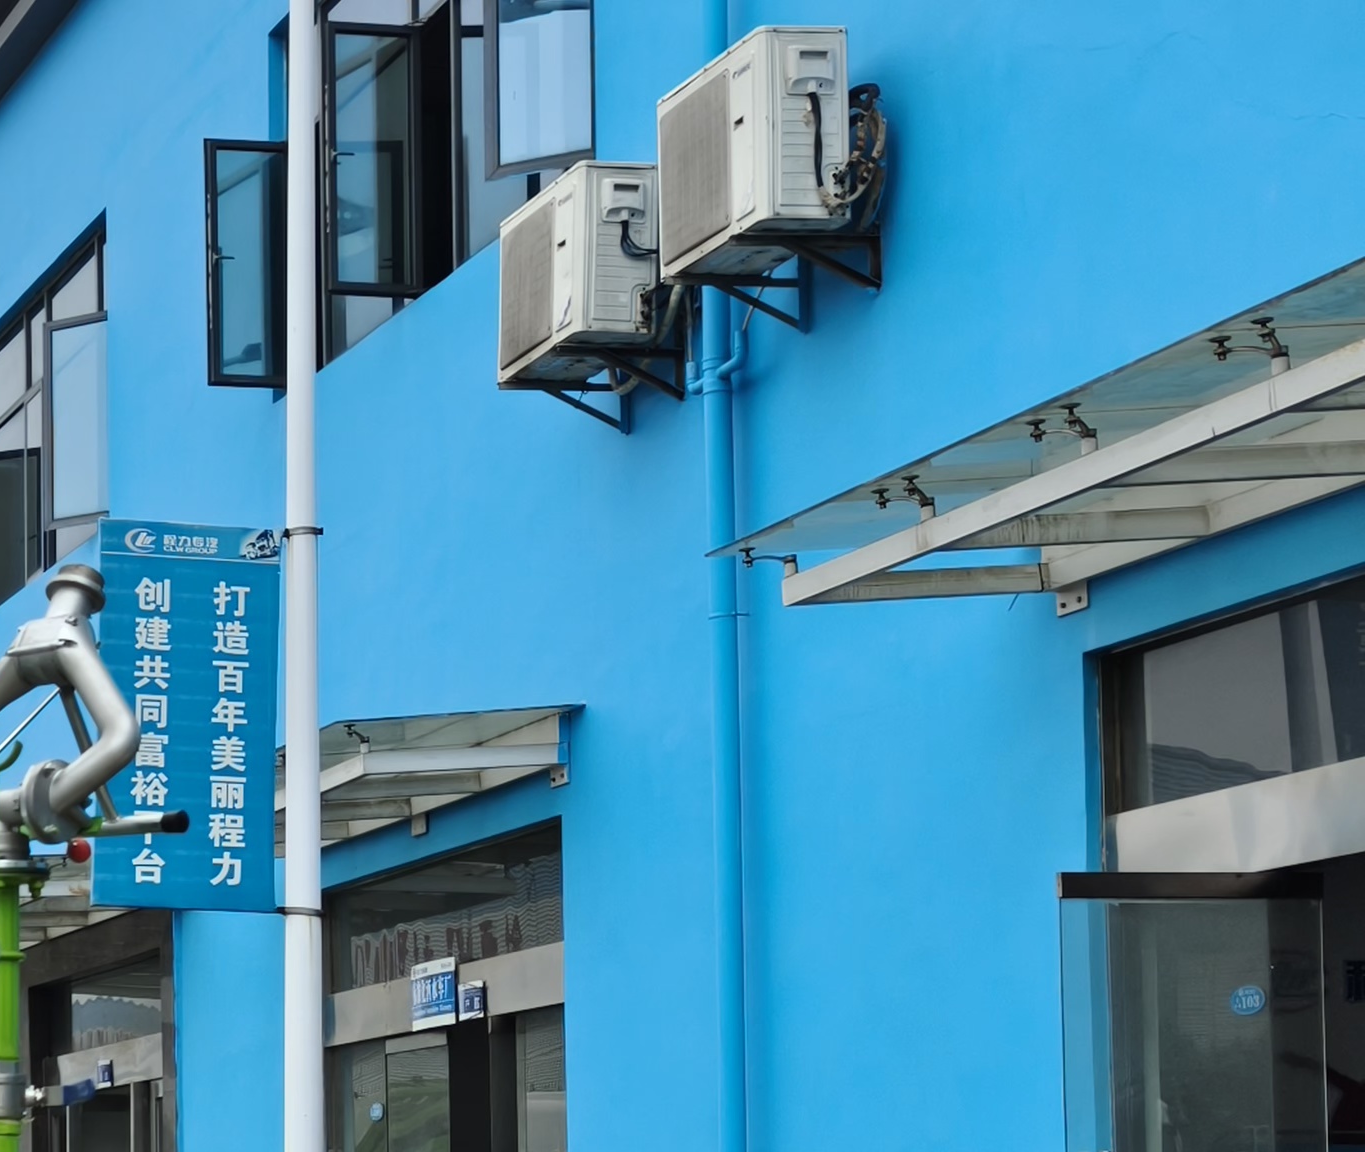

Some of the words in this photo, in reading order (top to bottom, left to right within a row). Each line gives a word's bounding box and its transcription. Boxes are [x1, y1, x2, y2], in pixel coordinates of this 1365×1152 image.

[185, 546, 218, 555] GROUP
[131, 577, 172, 885] 创建共同富裕台
[209, 581, 251, 887] 打造百年美丽程力
